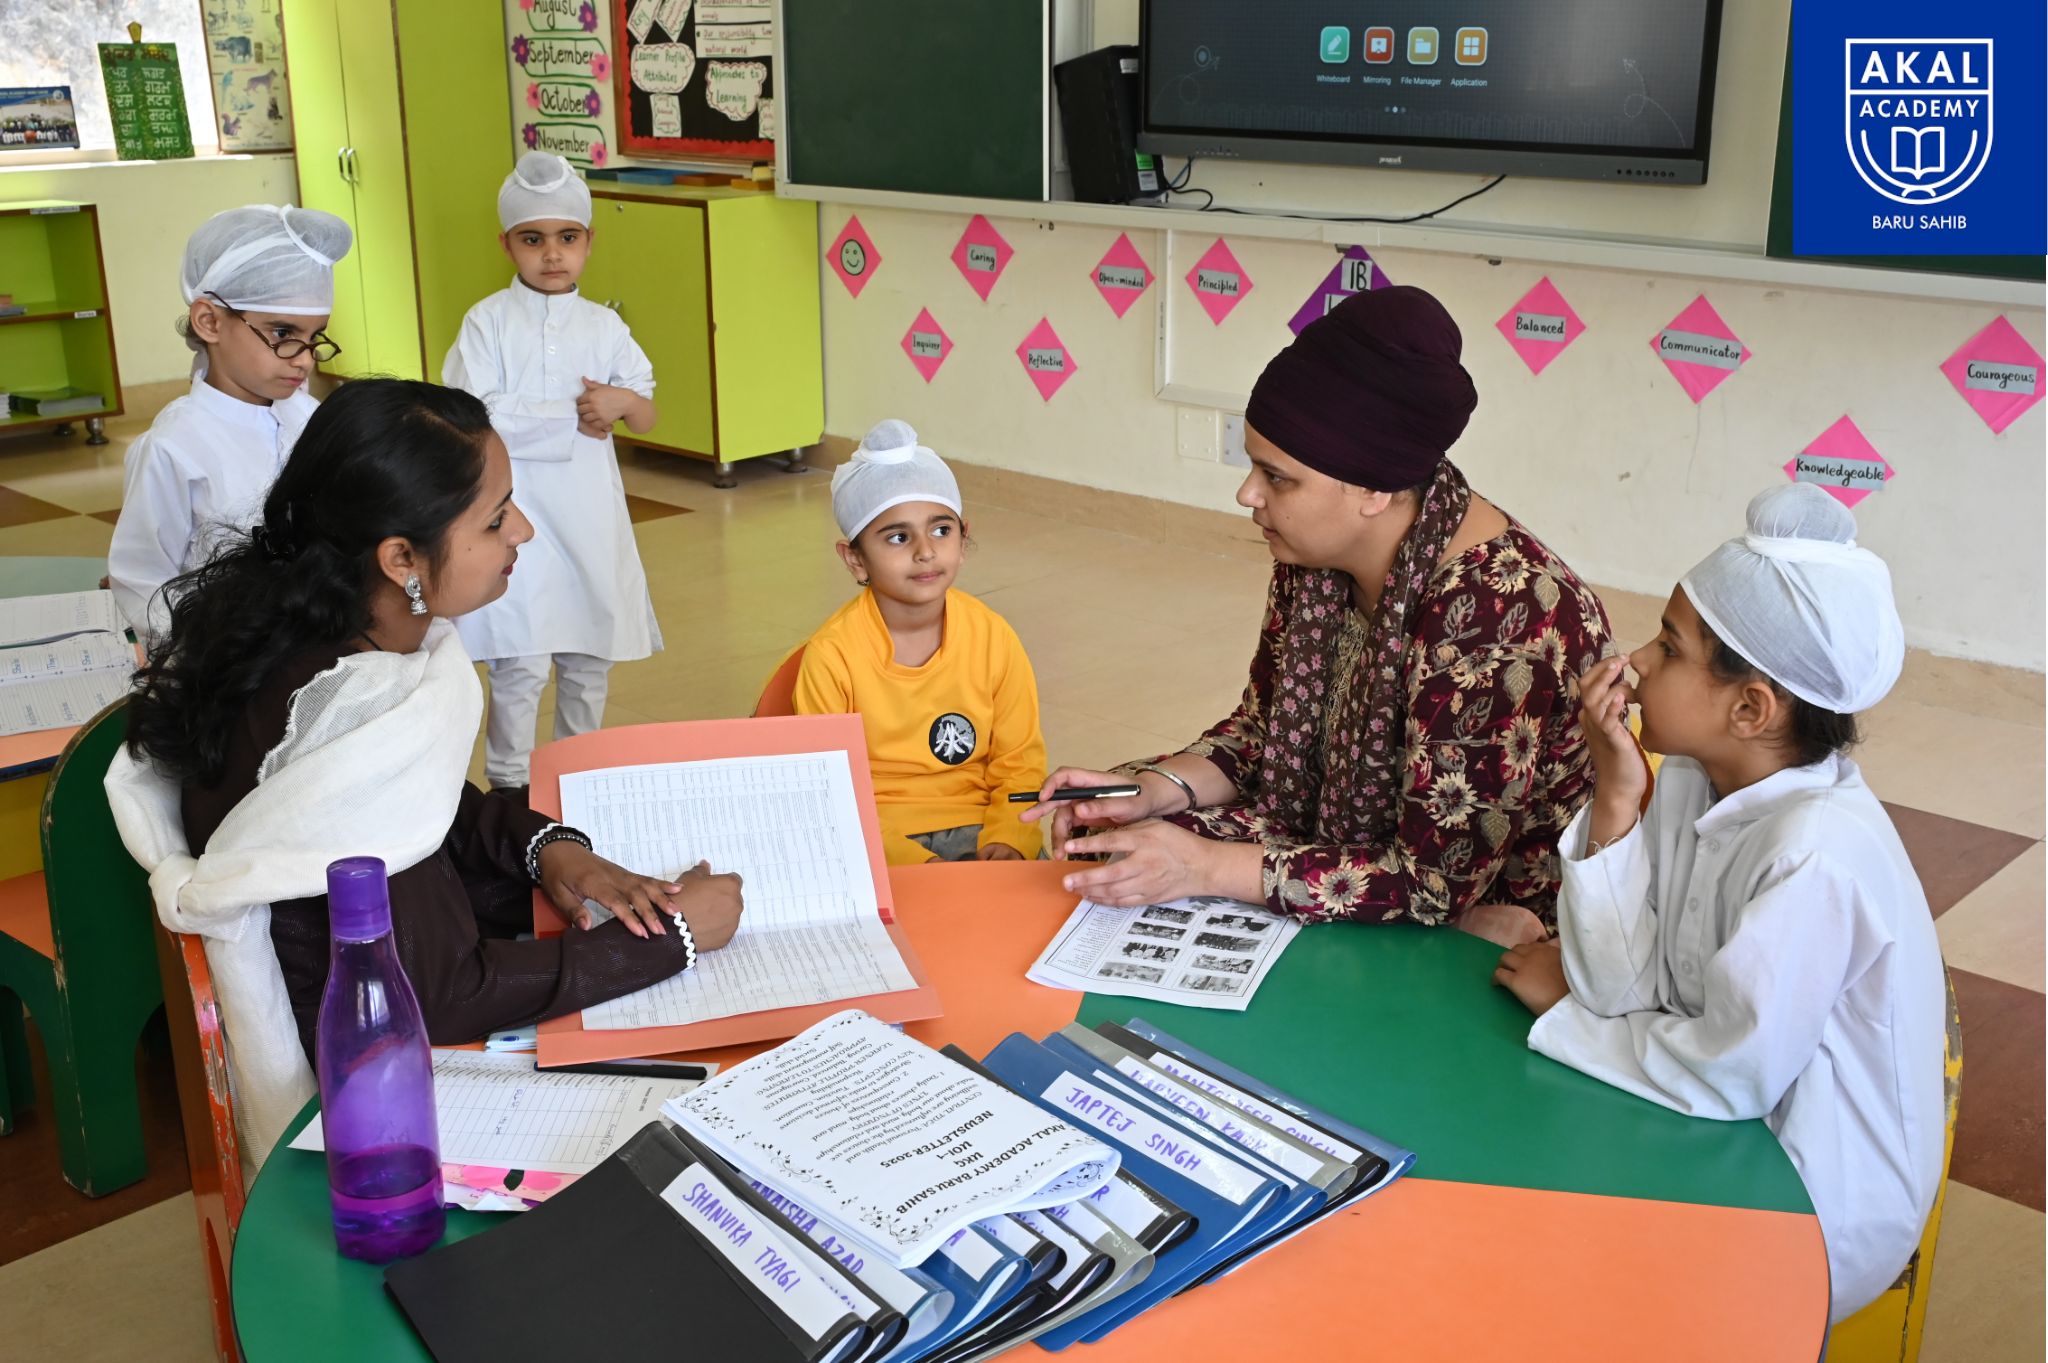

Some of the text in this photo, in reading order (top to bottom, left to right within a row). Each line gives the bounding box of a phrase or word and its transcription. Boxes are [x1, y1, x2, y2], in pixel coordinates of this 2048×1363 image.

[529, 41, 594, 74] September
[1316, 75, 1351, 84] Whiteboard
[1363, 76, 1391, 86] Mirroring
[1401, 77, 1442, 88] File Manager
[1450, 78, 1488, 87] Application
[541, 86, 586, 113] October
[537, 129, 589, 152] November
[969, 249, 996, 270] Caring
[1098, 272, 1145, 289] Open-minded
[1350, 261, 1367, 290] IB
[1198, 275, 1239, 295] Principled
[1515, 316, 1566, 336] Balanced
[912, 334, 941, 352] Inquirer
[1660, 335, 1741, 361] Communicator
[1028, 351, 1064, 369] Reflective
[1966, 363, 2036, 389] Courageous
[1795, 459, 1885, 487] Knowledgeable
[800, 1067, 814, 1075] TO
[916, 1074, 940, 1087] Daily
[891, 1086, 918, 1103] choices
[934, 1084, 955, 1098] about
[869, 1102, 891, 1114] about
[922, 1096, 935, 1106] our
[932, 1101, 945, 1111] are
[827, 1120, 848, 1133] mind
[880, 1116, 900, 1128] mind
[894, 1109, 932, 1131] influenced
[1065, 1086, 1202, 1171] JAPTEJ SINGH
[811, 1130, 828, 1143] and
[864, 1125, 880, 1134] and
[872, 1132, 885, 1140] the
[886, 1126, 922, 1144] Personal
[843, 1138, 871, 1153] choices
[862, 1140, 888, 1154] health
[879, 1110, 994, 1168] NEWSLETTER 2025
[830, 1152, 843, 1162] we
[845, 1151, 862, 1164] and
[953, 1151, 984, 1168] UKG
[896, 1124, 1066, 1214] AKAL ACADEMY BARU SAHIB
[682, 1182, 753, 1248] SHANVIKA
[754, 1246, 801, 1293] TYAGI
[820, 1235, 864, 1275] AZAD
